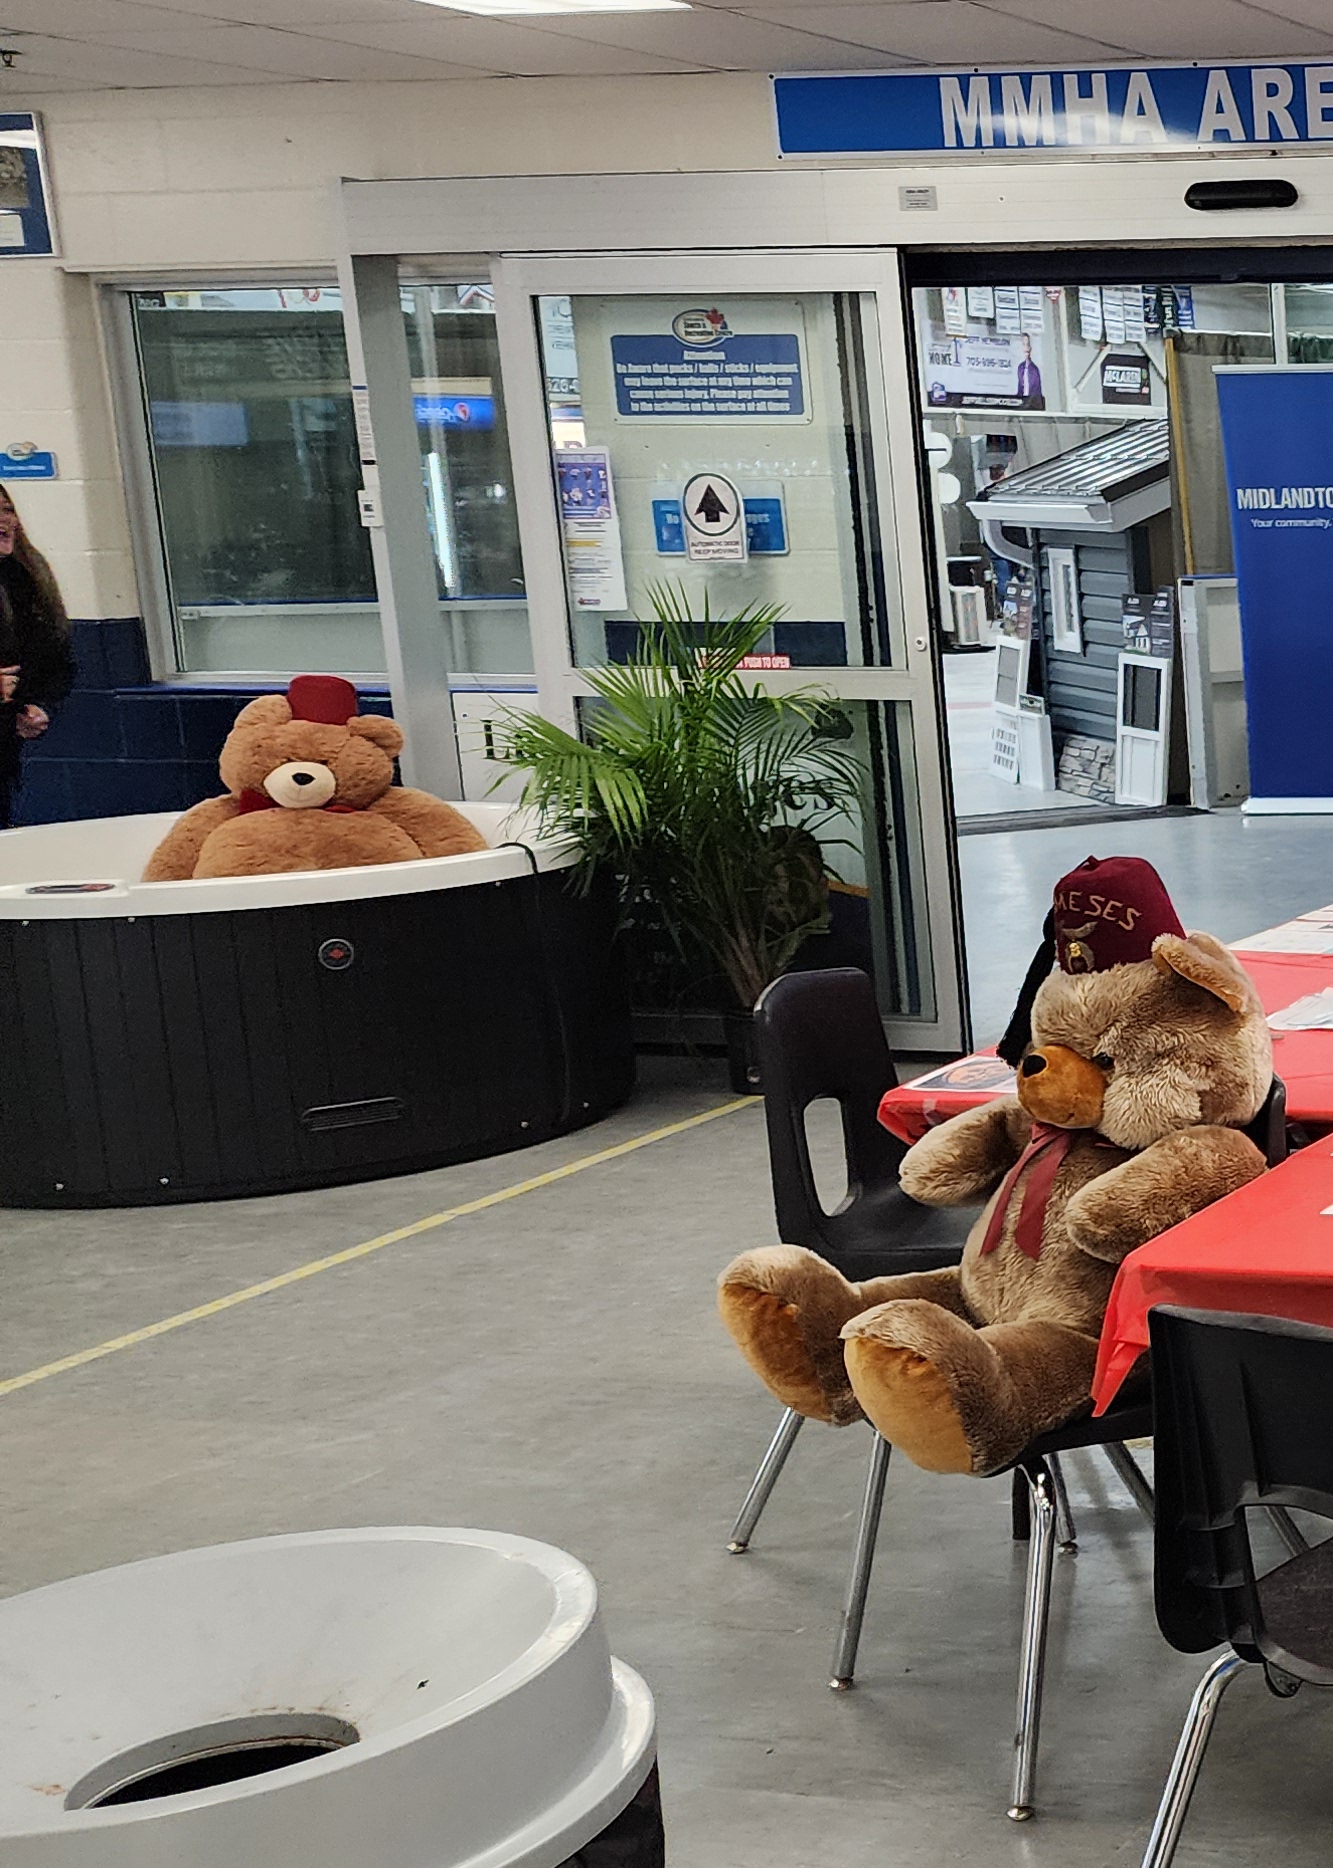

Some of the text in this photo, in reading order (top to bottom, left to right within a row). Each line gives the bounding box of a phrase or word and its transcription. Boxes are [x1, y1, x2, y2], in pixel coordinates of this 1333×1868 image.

[938, 72, 1168, 148] MMHA
[1250, 517, 1274, 529] Your
[1275, 517, 1332, 530] community.
[772, 656, 790, 668] OPEN
